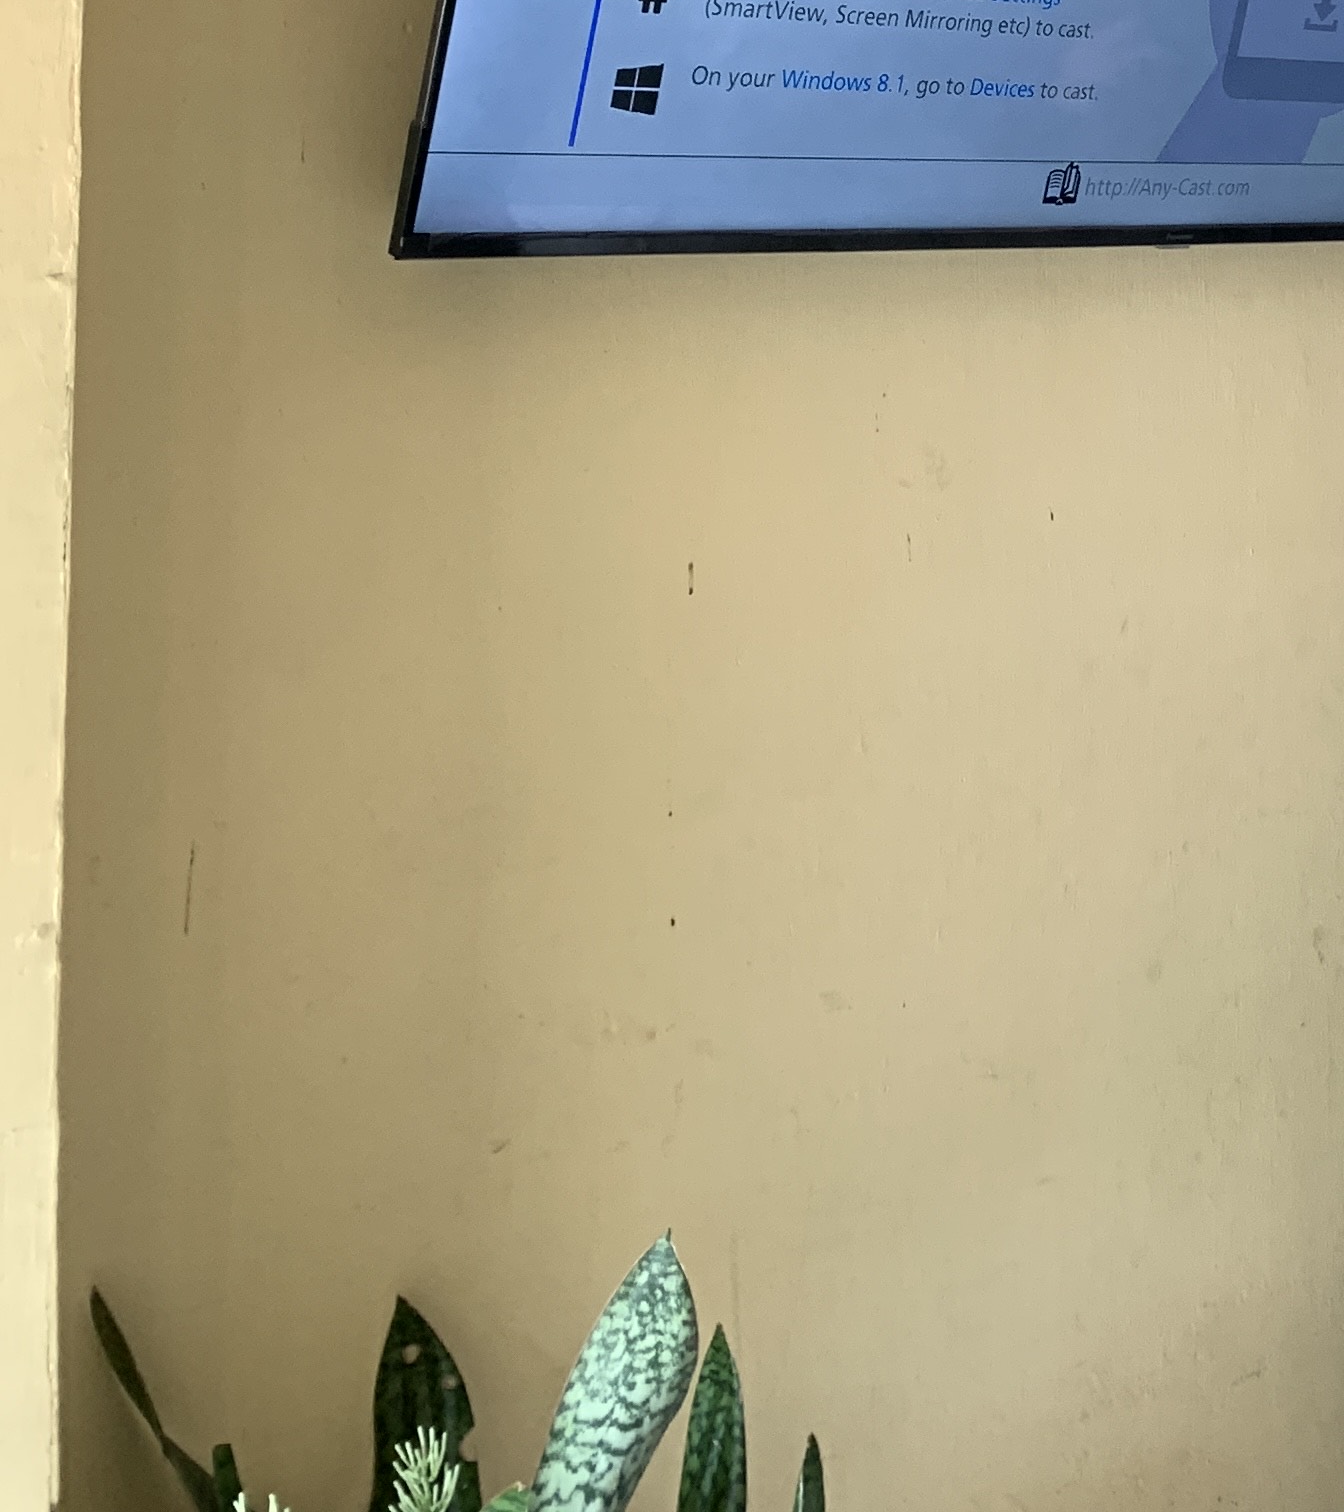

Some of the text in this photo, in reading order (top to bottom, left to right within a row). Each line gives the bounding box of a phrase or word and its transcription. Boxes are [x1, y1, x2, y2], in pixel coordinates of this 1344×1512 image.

[835, 4, 900, 28] Screen
[904, 11, 993, 38] Mirroring
[998, 16, 1031, 39] etc)
[1035, 19, 1055, 38] to
[1058, 20, 1095, 41] cast.
[691, 65, 1099, 103] On your Windows 8.1, go to Devices to cast.
[1085, 173, 1250, 202] http://Any-Cast.com
